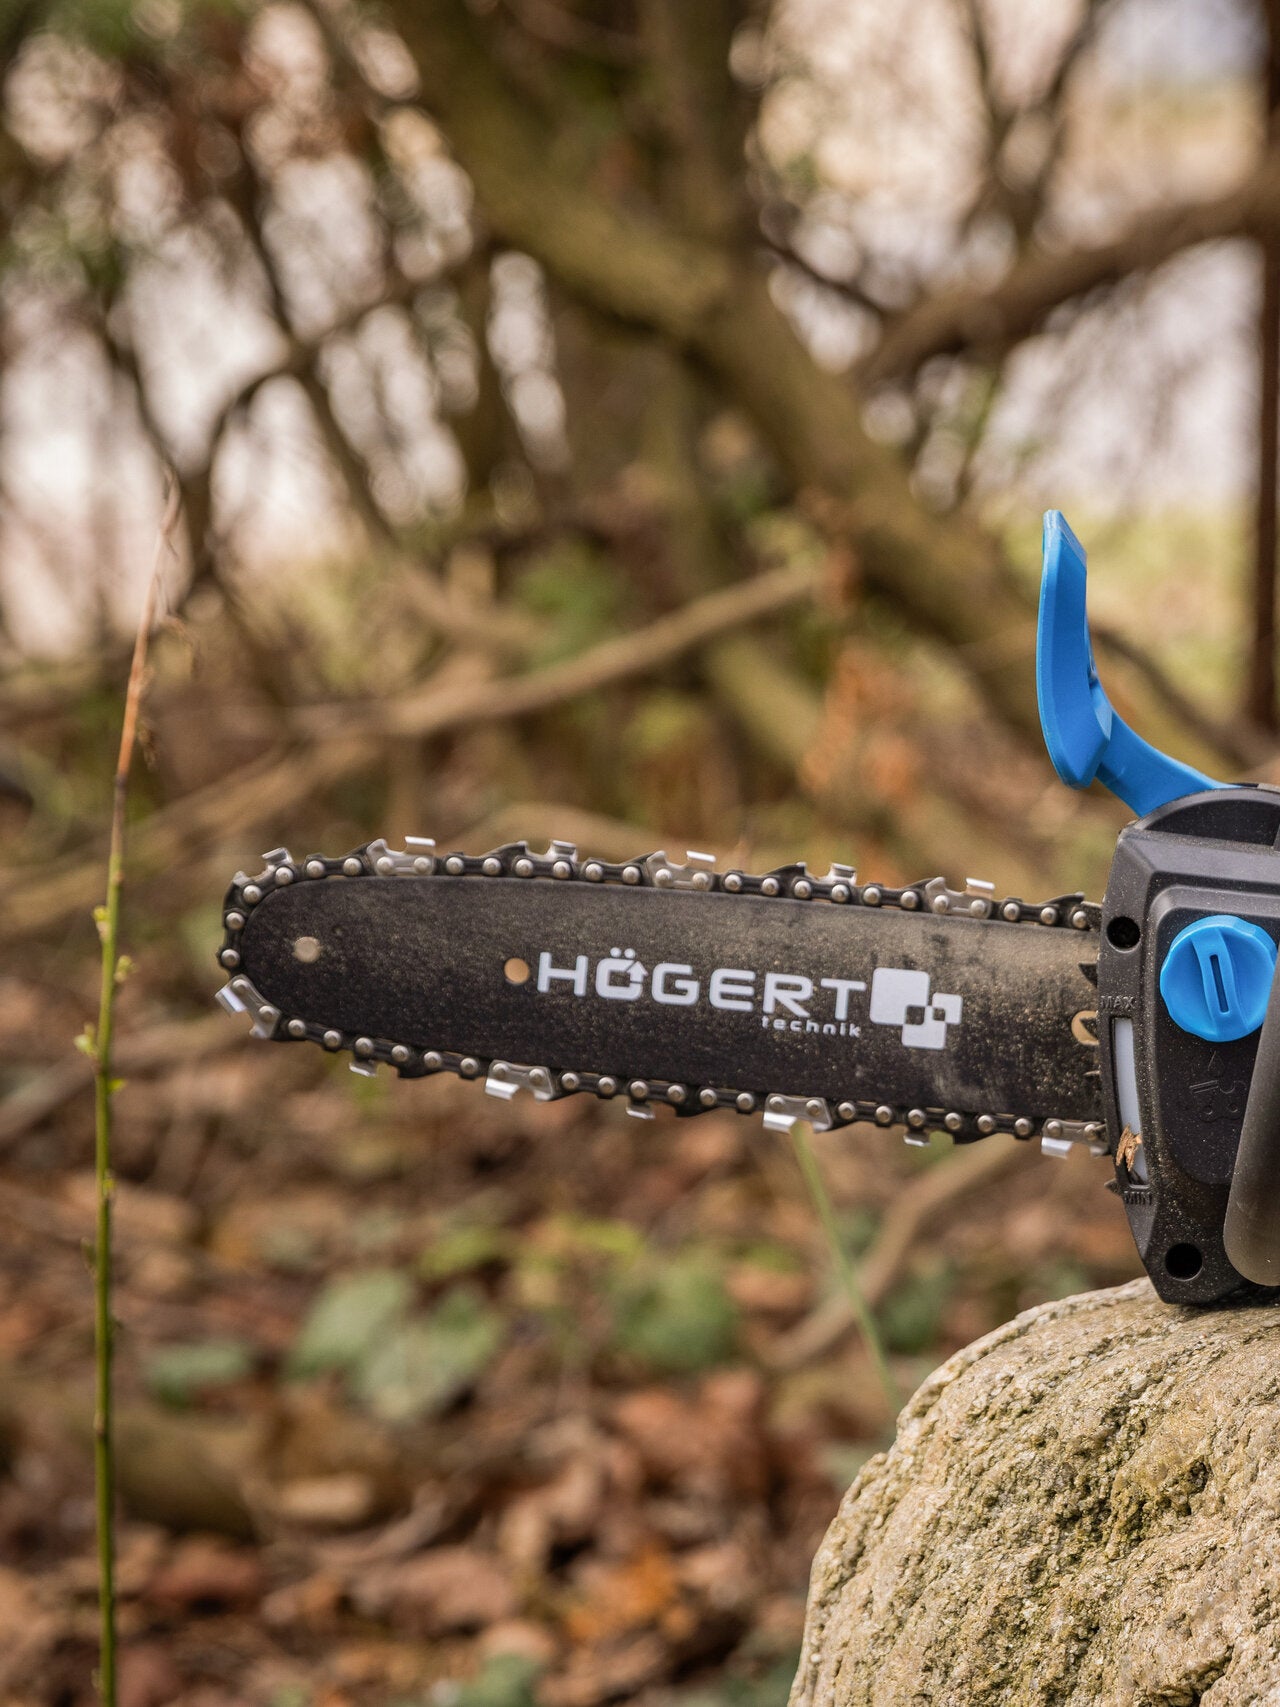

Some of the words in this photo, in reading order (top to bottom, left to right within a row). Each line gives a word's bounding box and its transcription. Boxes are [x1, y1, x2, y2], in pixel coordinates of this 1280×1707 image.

[537, 947, 866, 1022] HÖGERT
[1100, 995, 1135, 1009] MAX
[761, 1015, 861, 1039] technik
